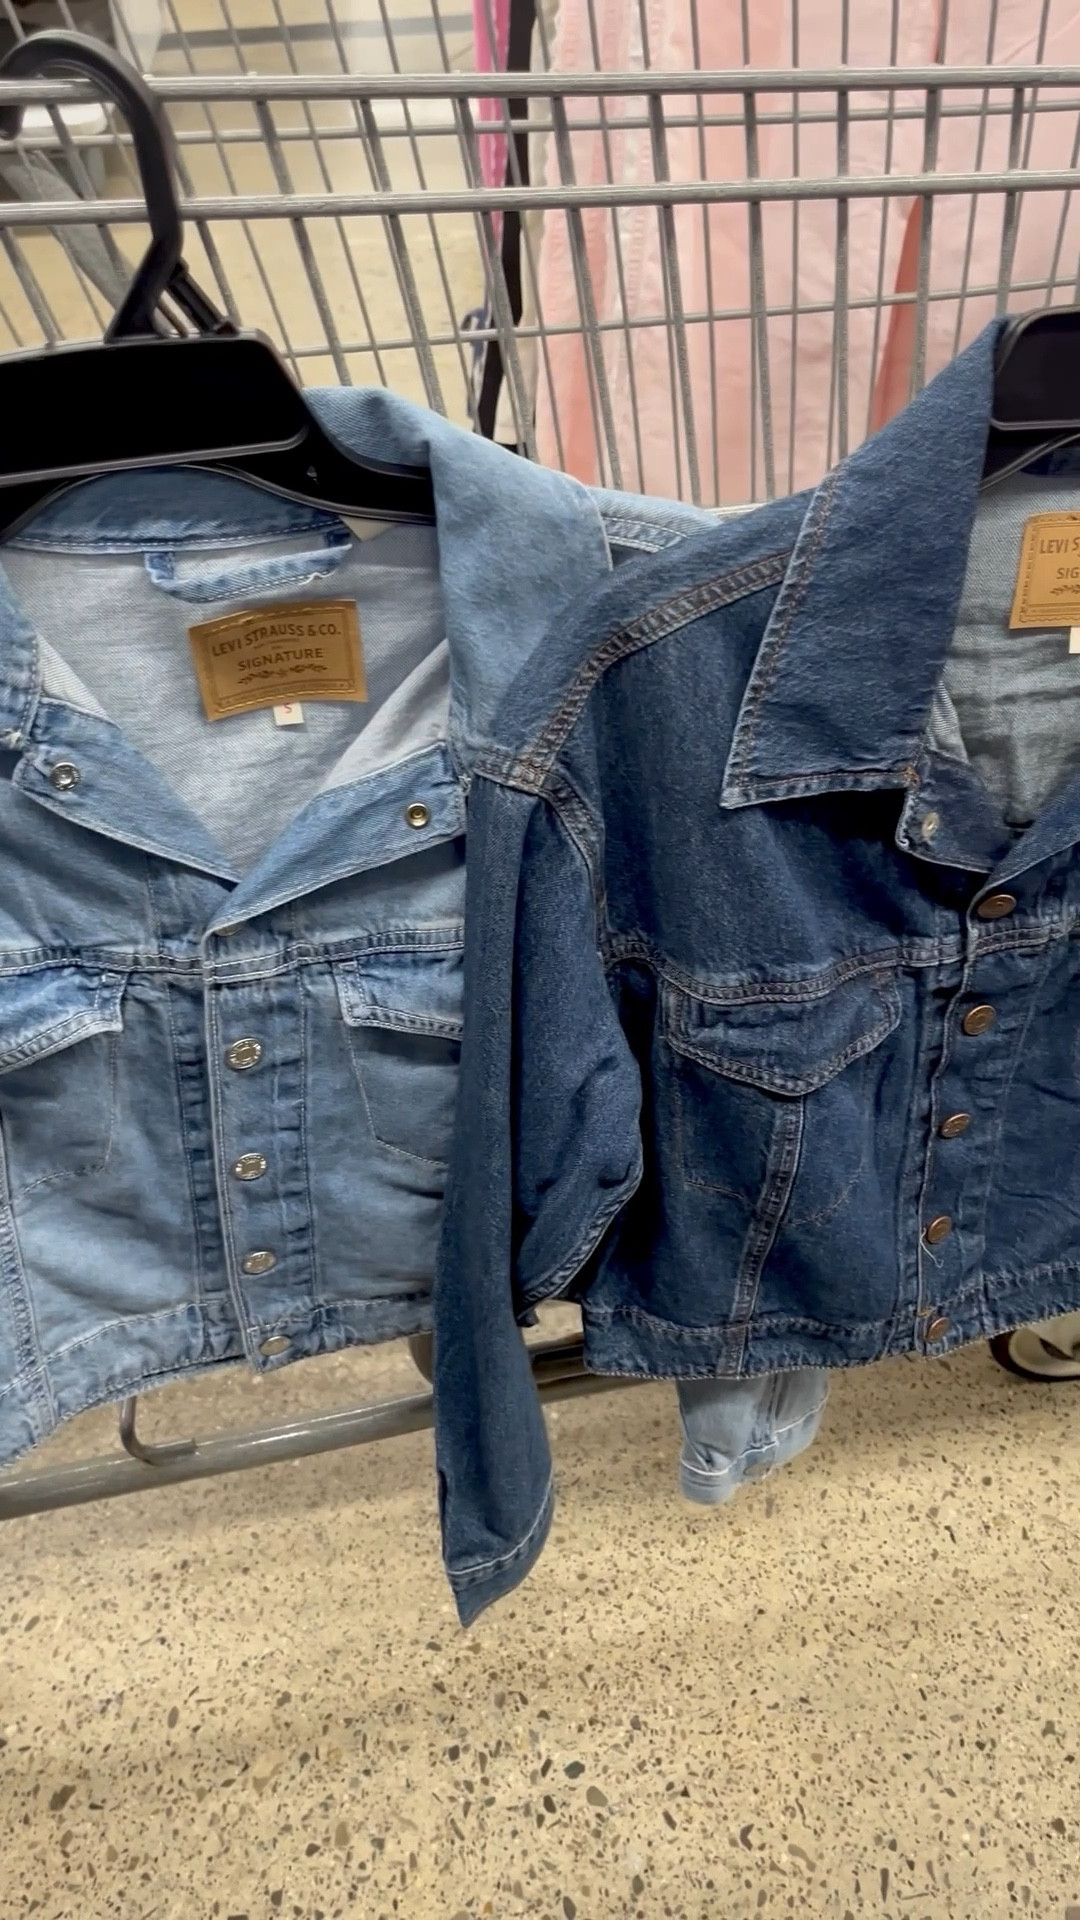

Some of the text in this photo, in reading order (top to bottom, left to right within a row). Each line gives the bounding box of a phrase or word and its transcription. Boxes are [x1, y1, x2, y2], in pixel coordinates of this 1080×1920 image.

[1039, 539, 1068, 554] LEVI
[212, 624, 341, 657] LEVI STRAUSS & CO.
[237, 648, 324, 671] SIGNATURE
